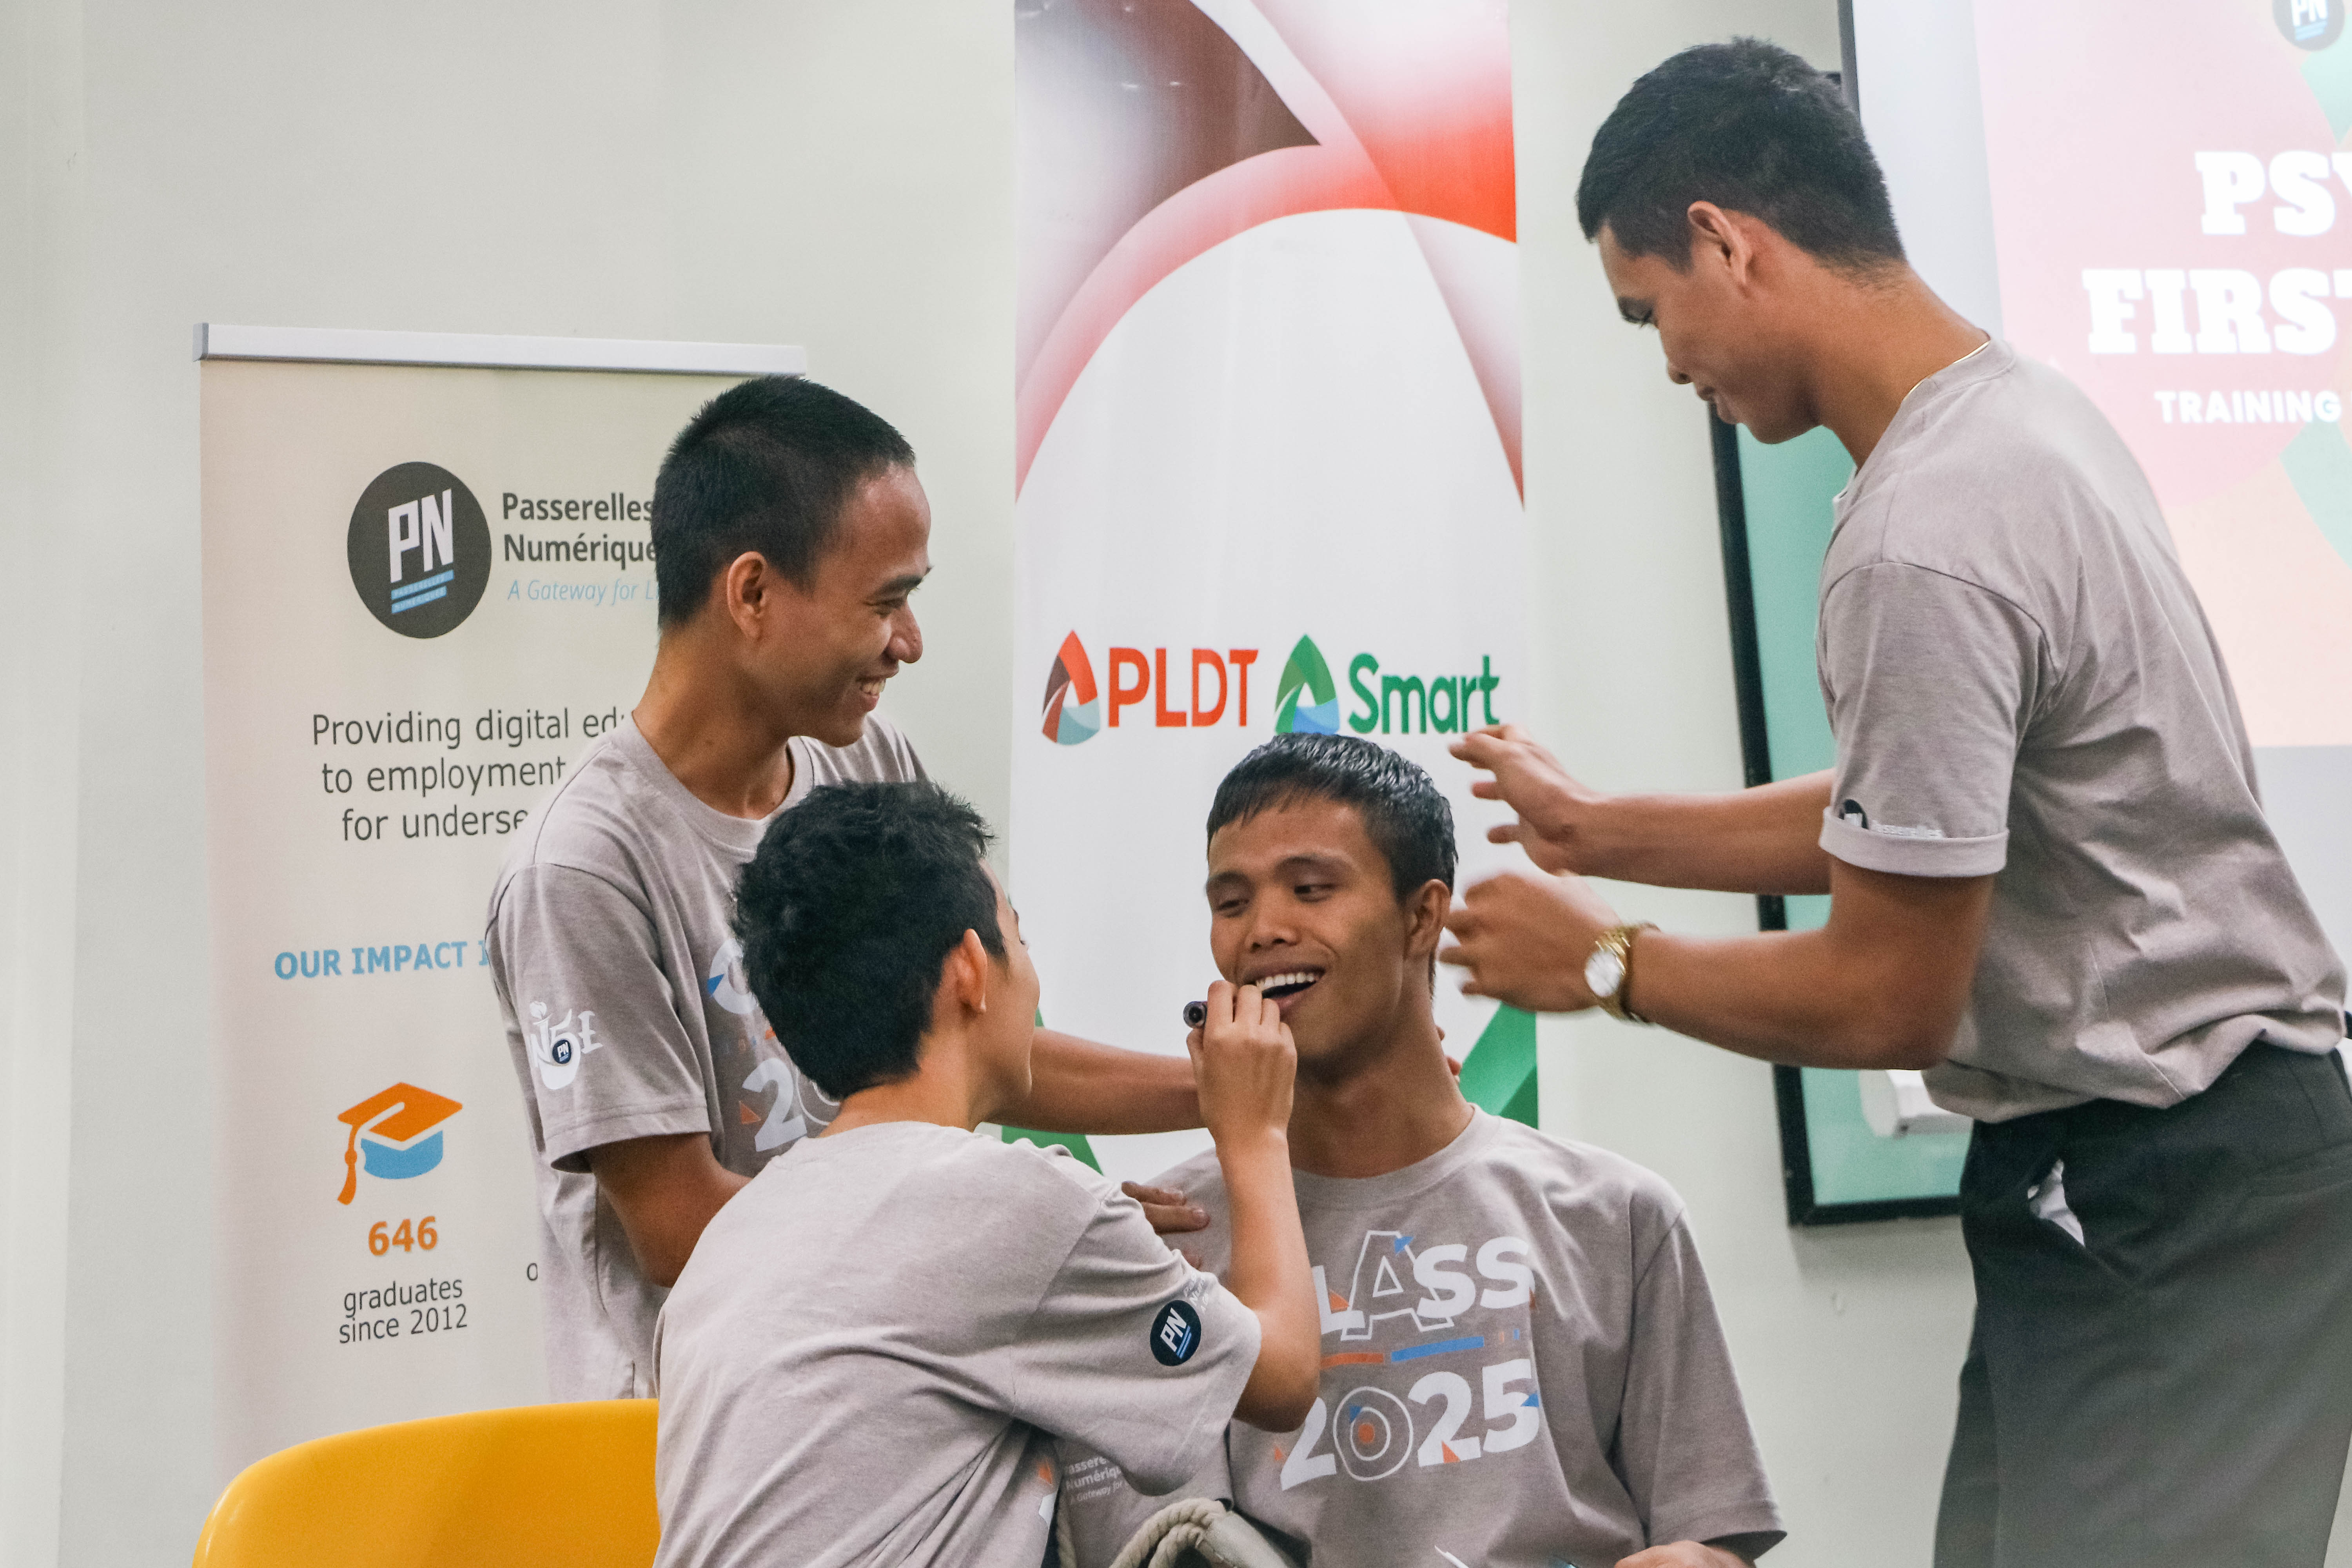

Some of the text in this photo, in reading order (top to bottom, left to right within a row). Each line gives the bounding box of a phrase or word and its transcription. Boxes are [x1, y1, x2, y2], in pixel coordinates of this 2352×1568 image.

[2195, 151, 2352, 236] PS
[2082, 267, 2352, 355] FIRS
[2154, 390, 2342, 423] TRAINING
[503, 492, 653, 521] Passerelles
[388, 488, 454, 583] PN
[508, 580, 520, 600] A
[528, 580, 607, 606] Gateway
[612, 579, 639, 607] for
[1108, 647, 1258, 727] PLDT
[1348, 653, 1500, 734] Smart
[314, 706, 624, 749] Providing digital ed
[322, 756, 566, 797] to employment
[343, 809, 388, 840] for
[275, 950, 341, 980] OUR
[352, 941, 468, 975] IMPACT
[368, 1216, 438, 1256] 646
[344, 1278, 463, 1318] graduates
[339, 1303, 468, 1344] since 2012
[1160, 1307, 1187, 1352] PN
[1280, 1358, 1540, 1491] 2025
